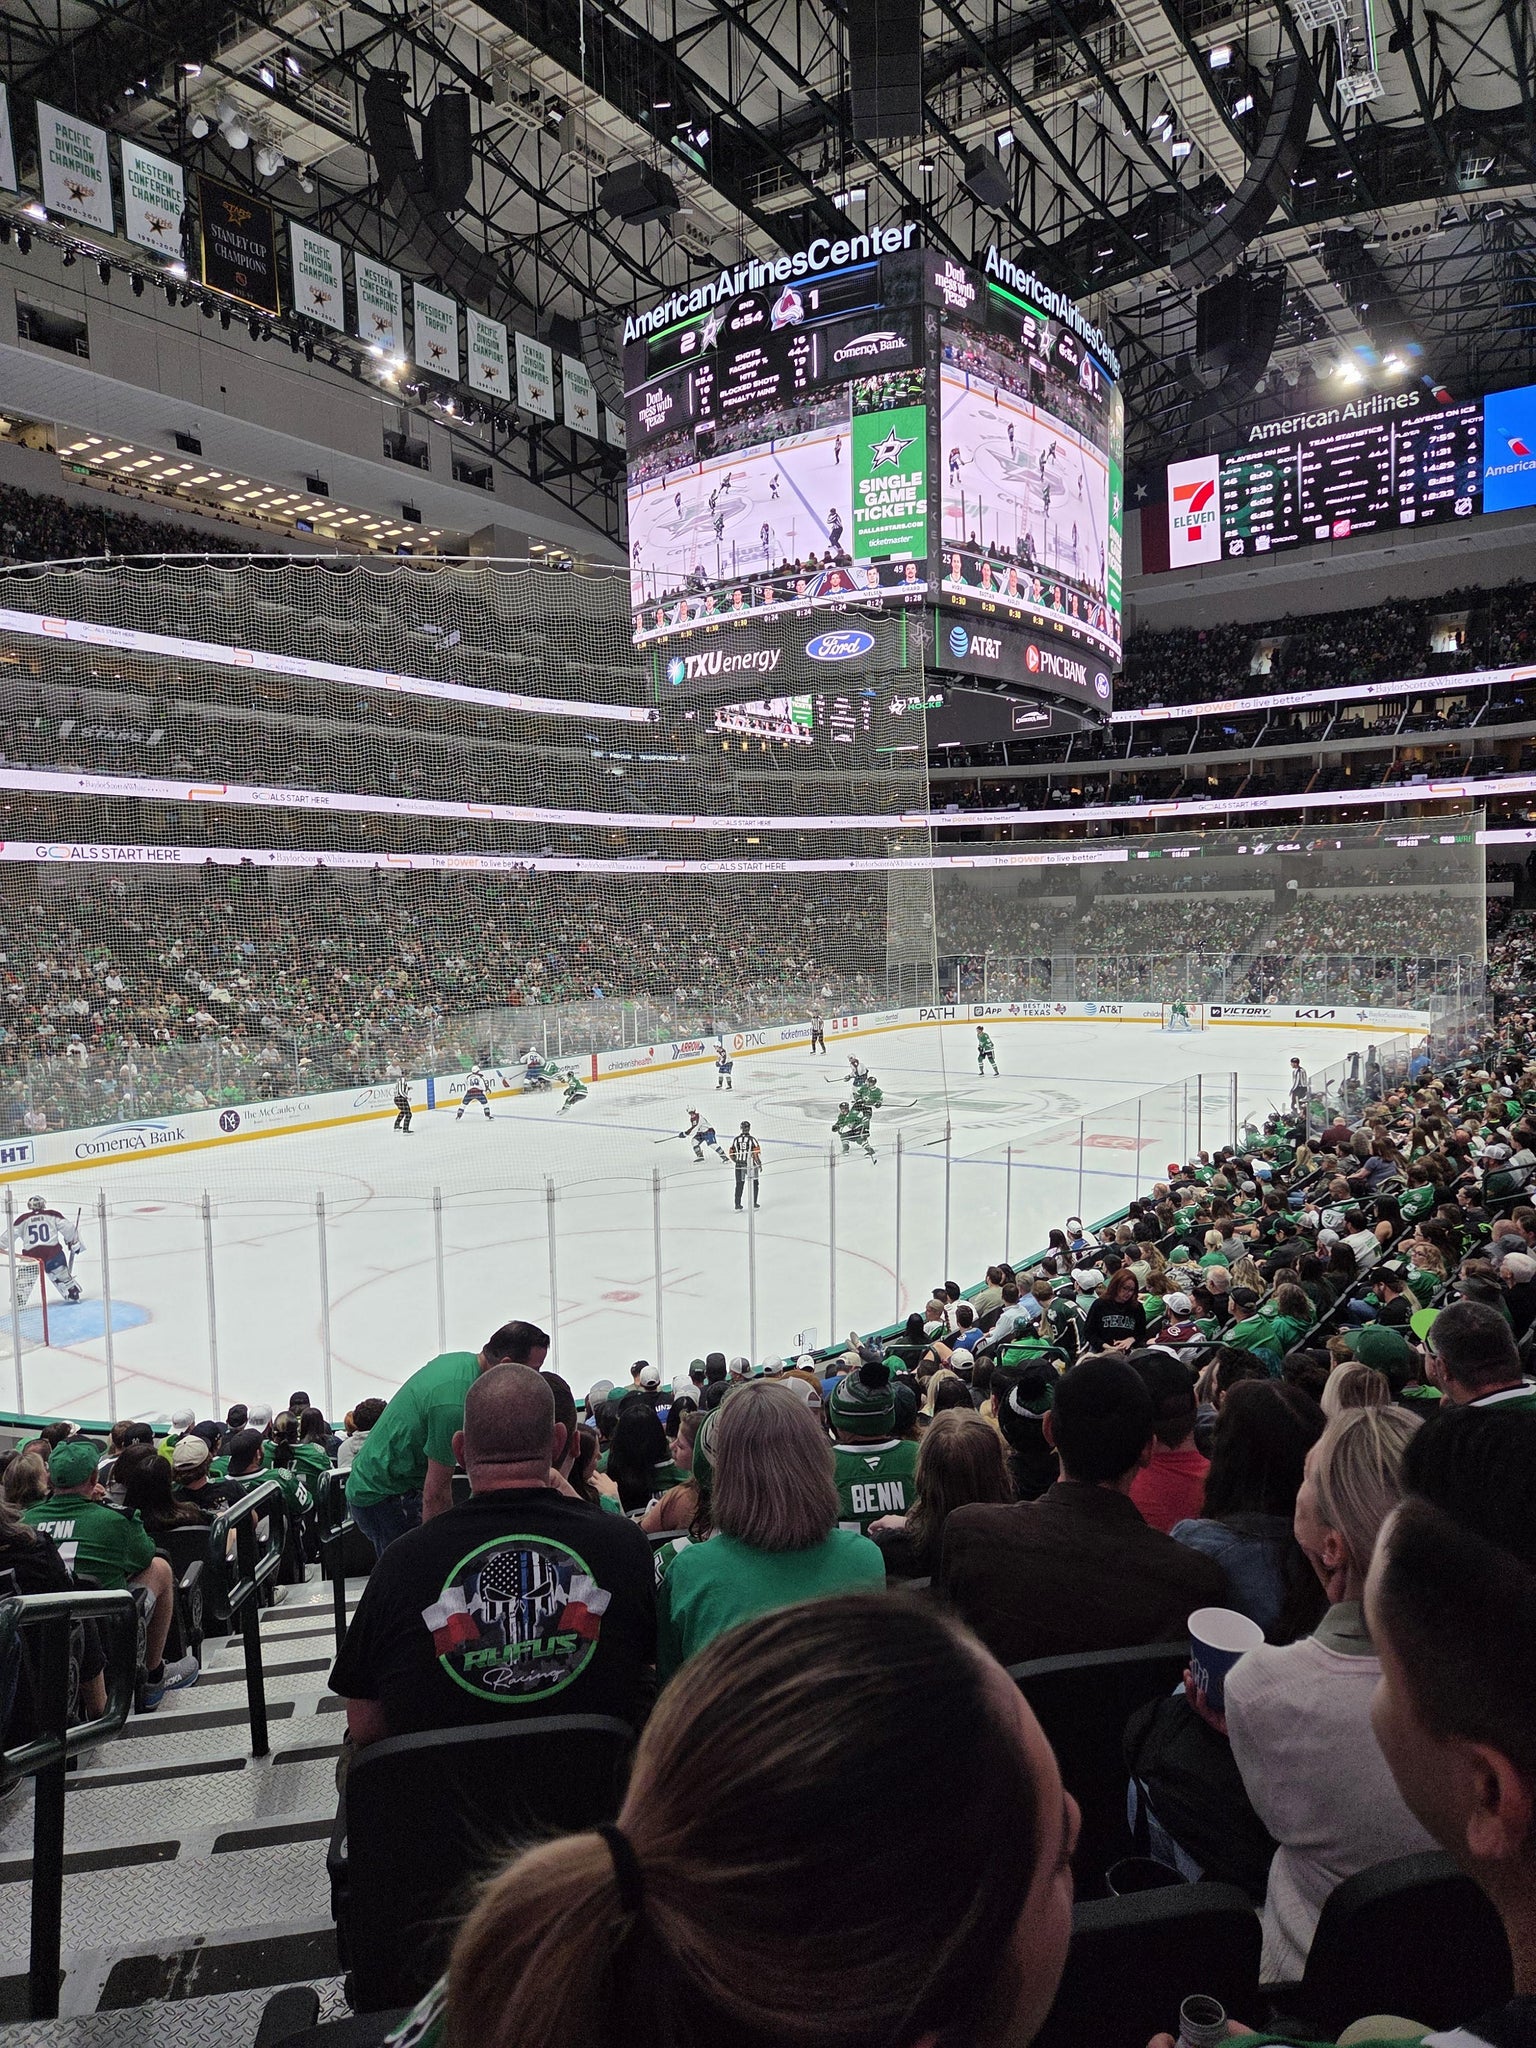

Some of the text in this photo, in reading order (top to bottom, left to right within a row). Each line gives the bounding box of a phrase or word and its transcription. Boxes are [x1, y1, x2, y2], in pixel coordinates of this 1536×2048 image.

[55, 122, 92, 149] PACIFIC
[55, 137, 95, 165] DIVISION
[50, 150, 103, 183] CHAMPIONS
[134, 158, 174, 186] WESTERN
[128, 169, 182, 203] CONFERENCE
[132, 186, 181, 216] CHAMPIONS
[211, 223, 266, 258] STANLEY CUP
[303, 238, 330, 260] PACIFIC
[215, 242, 267, 275] CHAMPIONS
[303, 251, 333, 273] DIVISION
[299, 262, 338, 289] CHAMPIONS
[364, 267, 393, 290] WESTERN
[359, 277, 399, 304] CONFERENCE
[808, 289, 819, 310] 1
[362, 291, 398, 316] CHAMPIONS
[425, 315, 448, 334] TROPHY
[477, 322, 498, 340] PACIFIC
[731, 310, 764, 331] 6:54
[1023, 316, 1036, 339] 2
[476, 334, 500, 352] DIVISION
[680, 331, 696, 353] 2
[735, 336, 806, 362] SHOTS 16
[880, 335, 906, 352] Bank
[472, 343, 504, 365] CHAMPIONS
[522, 344, 546, 363] CENTRAL
[520, 365, 549, 385] CHAMPIONS
[729, 361, 761, 374] FACEOFF
[740, 370, 757, 382] HITS
[720, 374, 780, 398] BLOCKED SHOTS
[723, 393, 755, 408] PENALTY
[757, 386, 777, 398] MINS
[644, 410, 666, 432] Texas
[1248, 388, 1420, 442] American Airlines
[1402, 405, 1476, 427] PLAYERS ON ICE
[1309, 425, 1384, 447] TEAM STATISTICS
[1394, 429, 1420, 438] PLAYER
[1467, 427, 1477, 436] 0
[1226, 446, 1291, 465] PLAYERS ON ICE
[1467, 456, 1477, 464] 0
[858, 471, 923, 494] SINGLE
[1467, 485, 1476, 493] 0
[865, 487, 917, 507] GAME
[854, 500, 927, 523] TICKETS
[1173, 510, 1215, 529] ELEVEN
[858, 521, 924, 535] DALLASSTARS.COM
[942, 553, 951, 564] 25
[894, 565, 903, 574] 49
[818, 634, 861, 658] Ford
[970, 635, 1001, 659] AT&T
[1176, 696, 1270, 717] The power to live
[286, 794, 310, 803] START
[311, 796, 330, 804] HERE
[101, 848, 143, 860] START
[147, 849, 181, 861] HERE
[432, 858, 445, 866] The
[447, 858, 479, 868] power
[994, 857, 1008, 865] The
[1010, 855, 1045, 865] power
[1056, 854, 1070, 862] live
[738, 862, 763, 871] START
[920, 1007, 955, 1021] PATH
[1099, 1005, 1123, 1014] AT&T
[1223, 1007, 1268, 1015] VICTORY
[681, 1041, 701, 1053] ARROW
[746, 1032, 766, 1047] PNC
[150, 1128, 185, 1145] Bank
[28, 1223, 50, 1245] 50
[1102, 1315, 1136, 1331] TEXAS
[851, 1481, 905, 1514] BENN
[463, 1633, 577, 1671] RUFUS
[483, 1667, 565, 1691] Racing
